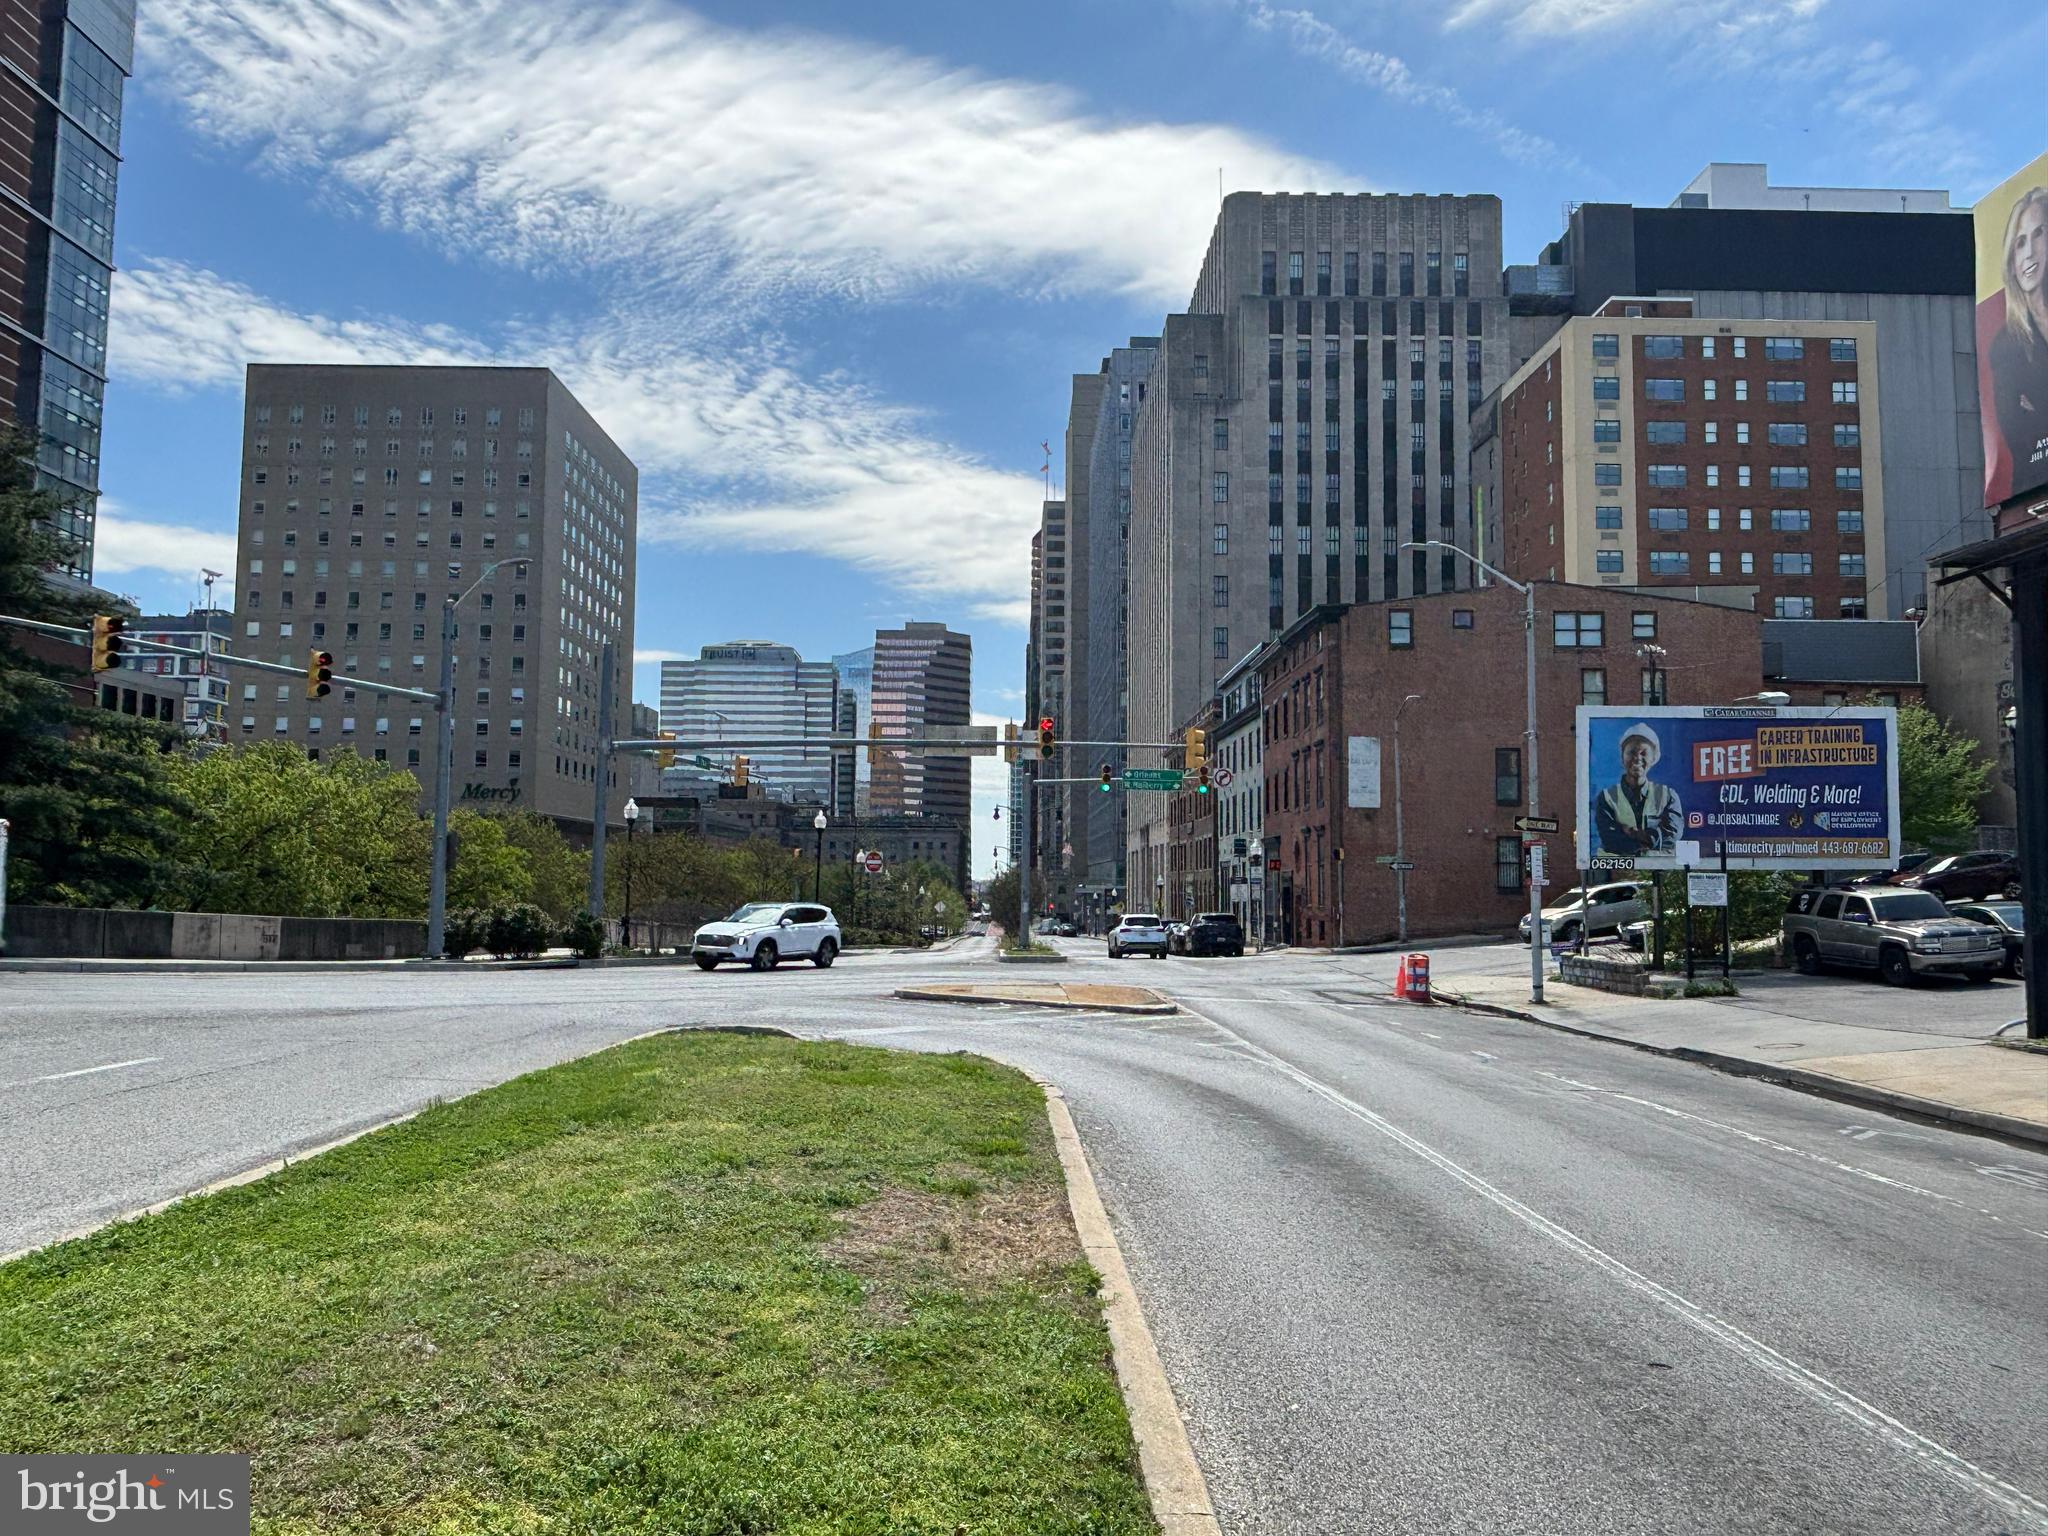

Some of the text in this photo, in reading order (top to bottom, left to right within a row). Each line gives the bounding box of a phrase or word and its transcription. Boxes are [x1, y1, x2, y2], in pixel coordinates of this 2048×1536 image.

[1760, 728, 1861, 746] CAREER TRAINING
[1700, 744, 1752, 777] FREE
[1760, 747, 1875, 765] IN INFRASTRUCTURE
[461, 783, 521, 804] Mercy
[1720, 784, 1862, 808] CDL, Welding & More!
[1707, 813, 1780, 826] @JOBSBALTIMORE
[1714, 840, 1884, 857] bltimorecity.gov/moed 443-687-6682
[1591, 859, 1633, 869] 062150
